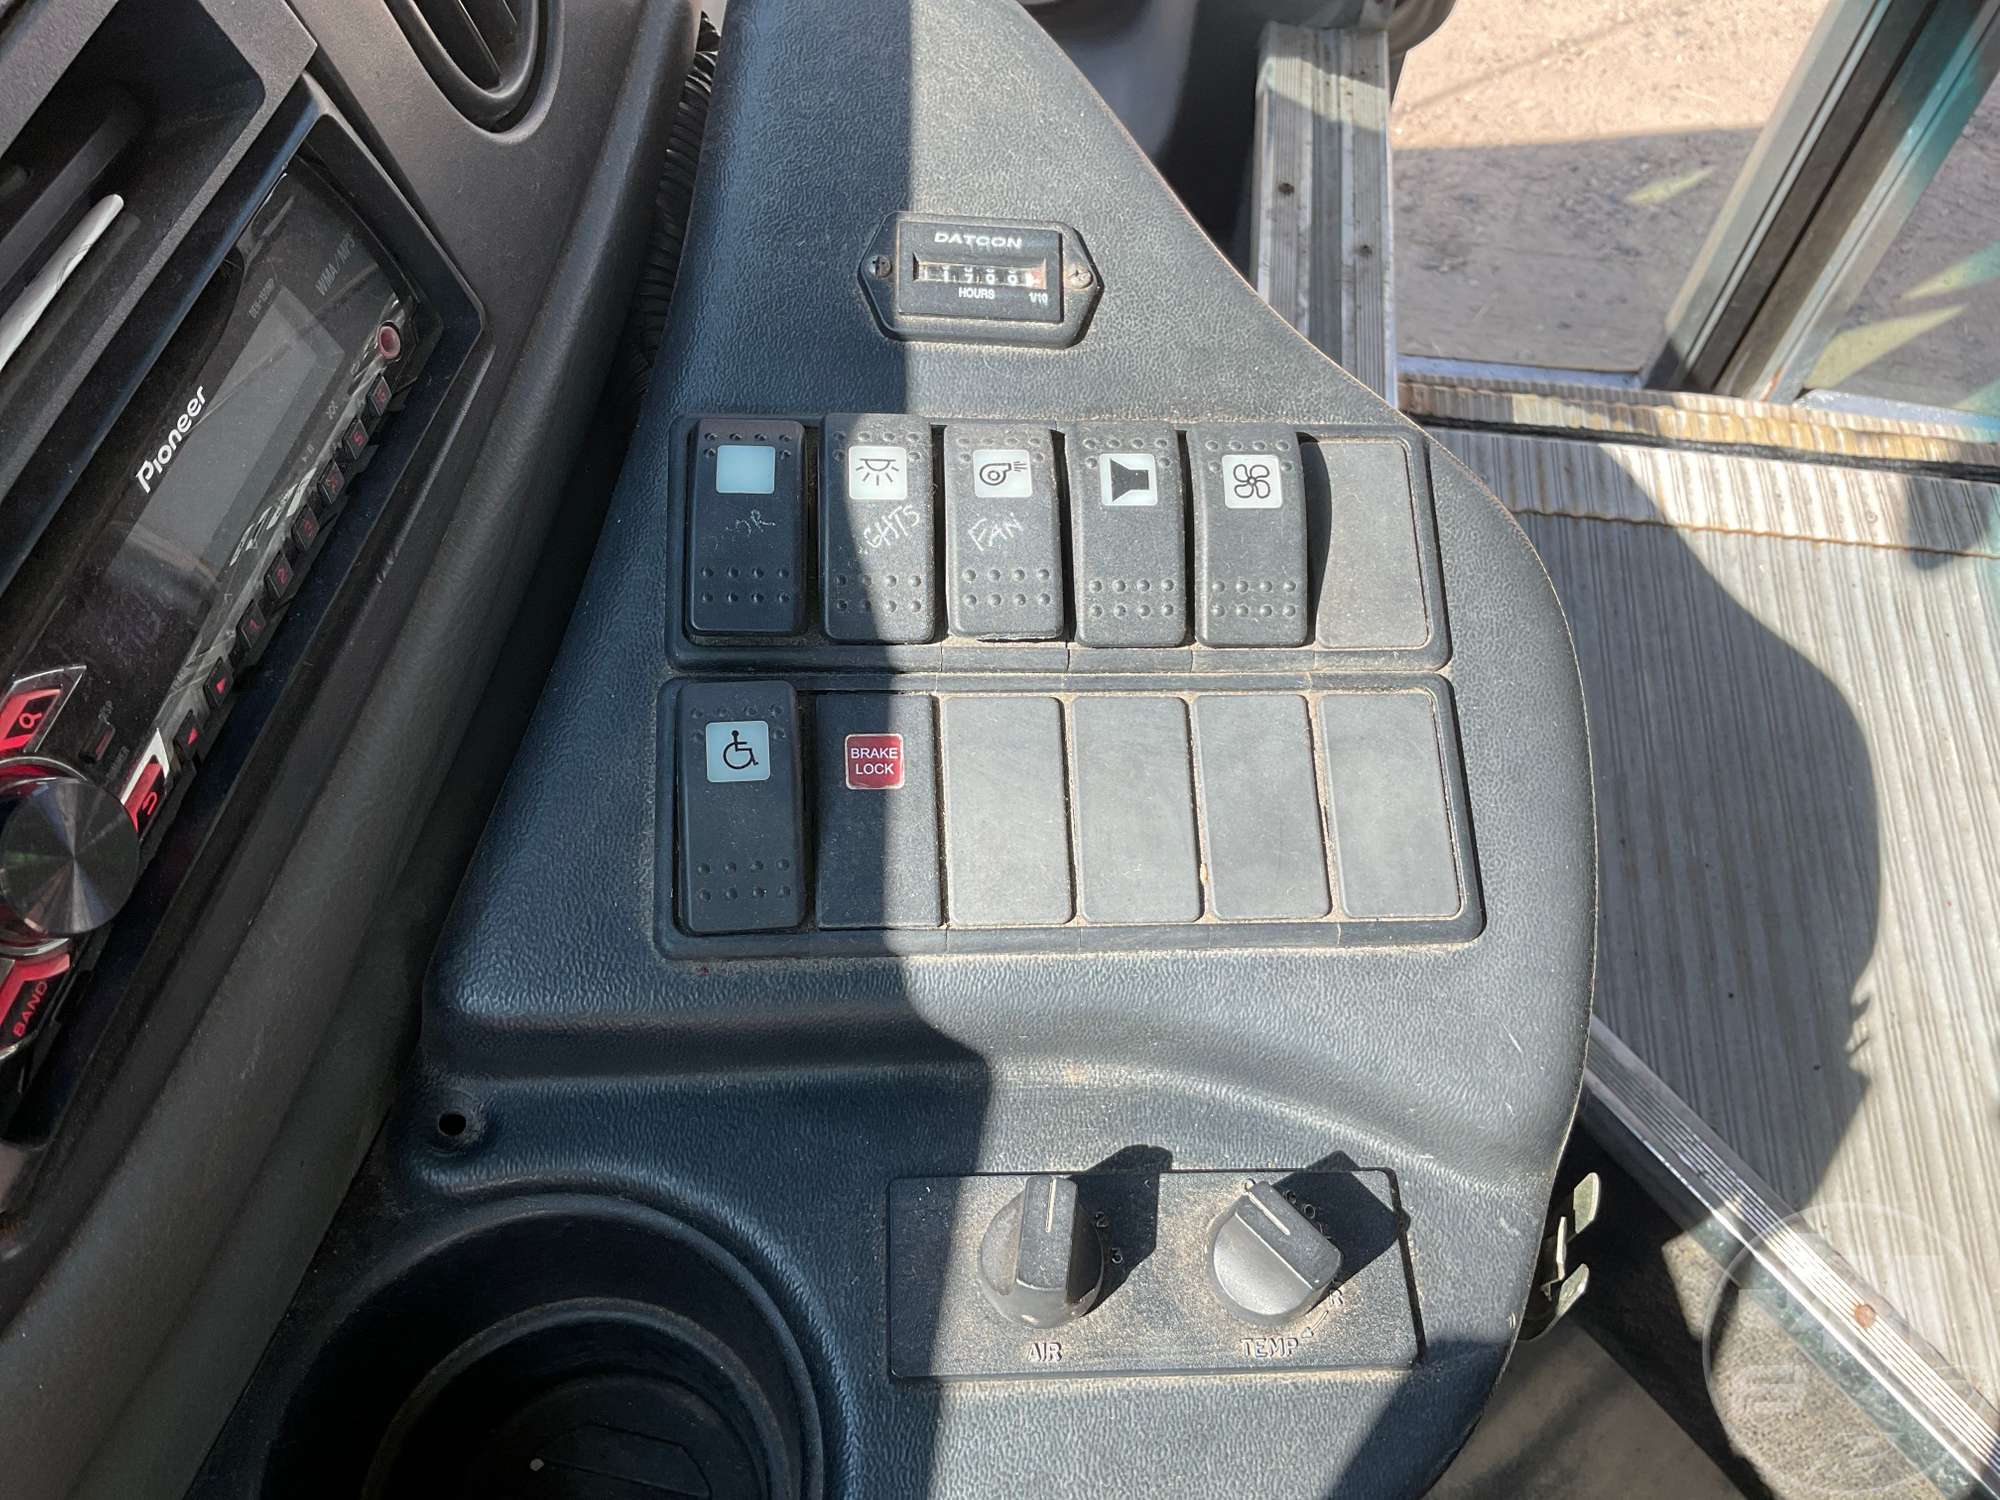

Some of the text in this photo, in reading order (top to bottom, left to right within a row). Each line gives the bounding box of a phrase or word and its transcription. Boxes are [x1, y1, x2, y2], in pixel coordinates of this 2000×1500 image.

[934, 231, 1023, 249] DATCON
[958, 286, 996, 301] HOURS
[135, 385, 206, 494] Pioneer
[850, 747, 899, 759] BRAKE
[855, 763, 895, 775] LOCK
[12, 980, 48, 1038] BAND
[1095, 1210, 1110, 1229] 2
[1111, 1246, 1124, 1264] 3
[1027, 1341, 1063, 1363] AIR
[1239, 1337, 1299, 1359] TEMP
